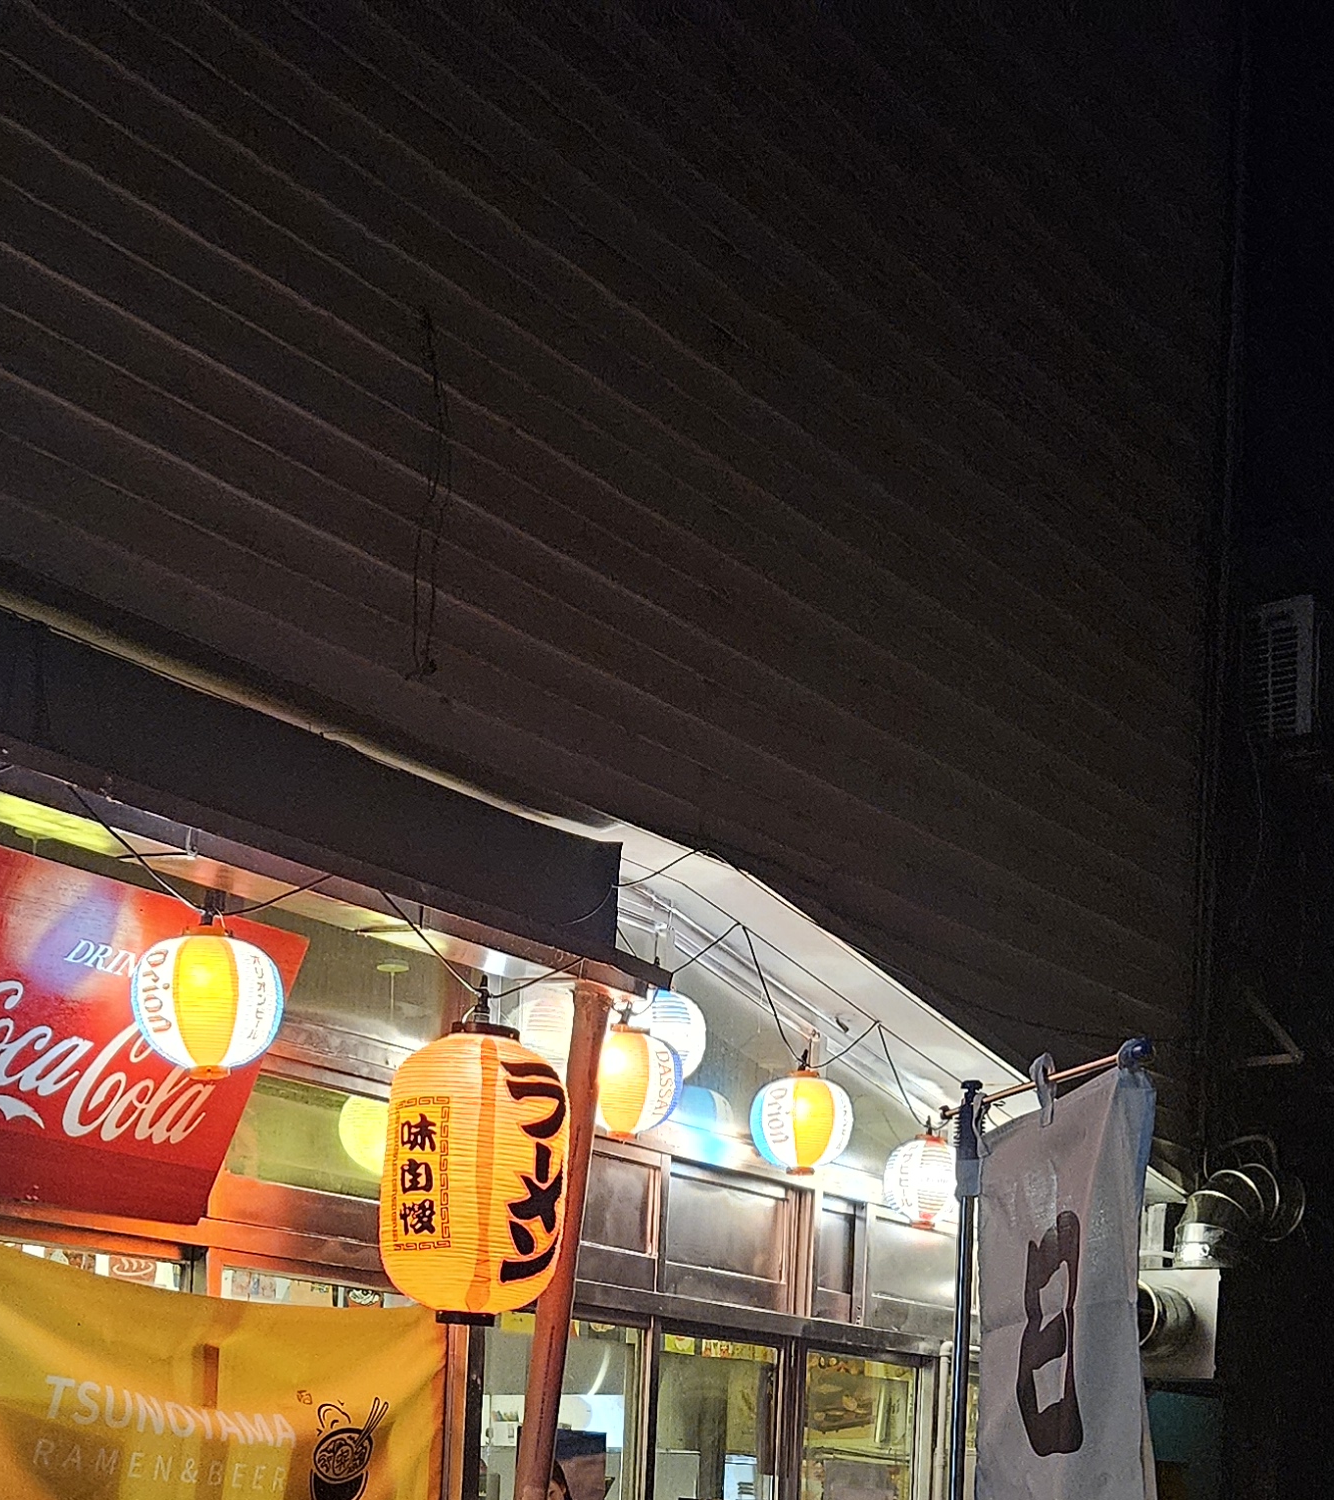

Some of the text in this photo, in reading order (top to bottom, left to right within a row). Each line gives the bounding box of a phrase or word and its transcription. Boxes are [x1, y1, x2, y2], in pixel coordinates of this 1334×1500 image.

[64, 938, 138, 978] DRIN
[142, 949, 172, 1033] Orion
[655, 1050, 674, 1118] DASSAI
[767, 1086, 790, 1145] Orion
[399, 1112, 437, 1236] 味自慢
[499, 1060, 567, 1284] ラーメン
[44, 1374, 297, 1450] TSUNOYAMA
